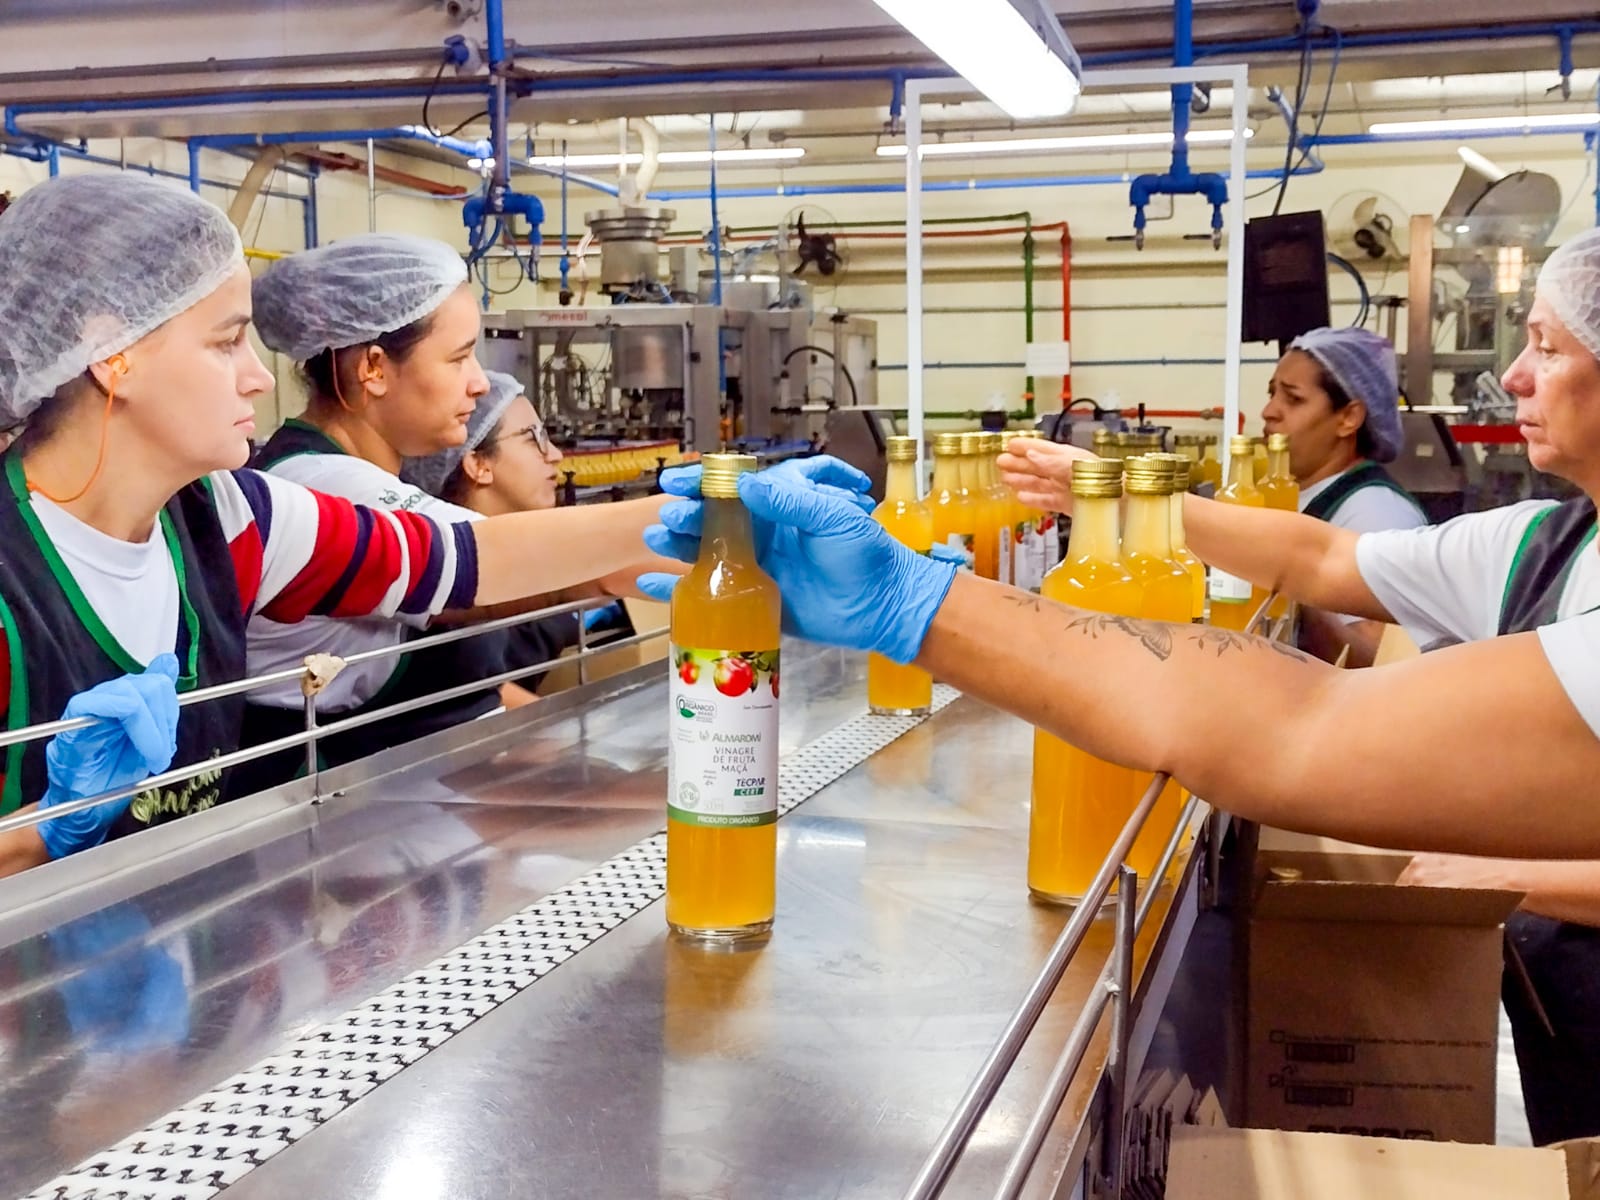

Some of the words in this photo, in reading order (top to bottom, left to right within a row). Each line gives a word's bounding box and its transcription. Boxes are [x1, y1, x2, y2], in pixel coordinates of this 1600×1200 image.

[714, 746, 755, 755] VINAGRE
[712, 755, 726, 764] DE
[728, 755, 756, 764] FRUTA
[697, 815, 728, 824] PRODUTO
[729, 815, 760, 825] ORGÂNICO
